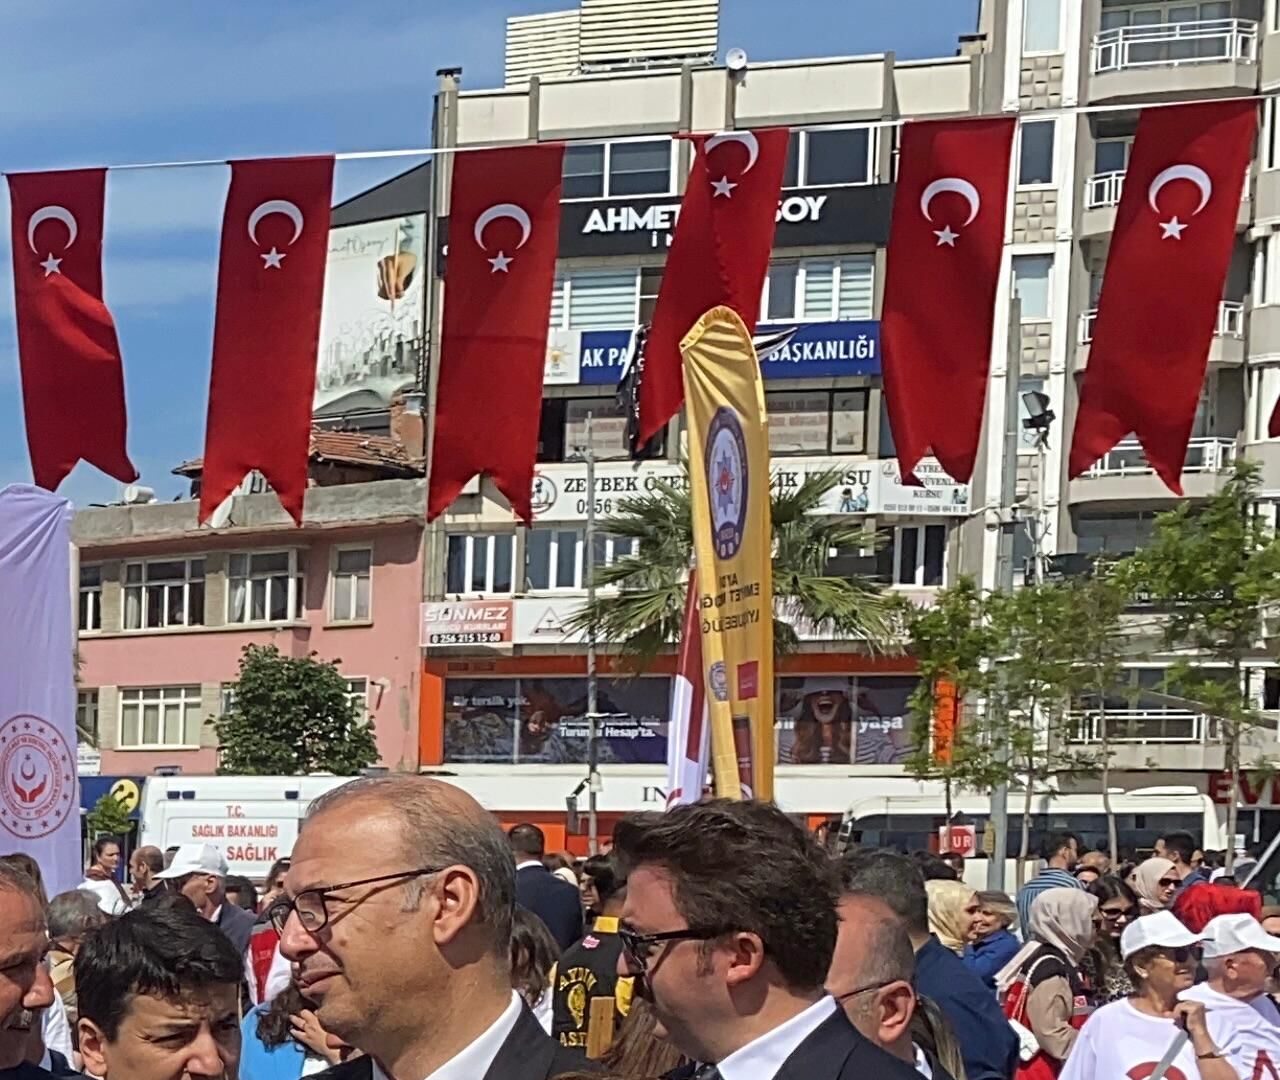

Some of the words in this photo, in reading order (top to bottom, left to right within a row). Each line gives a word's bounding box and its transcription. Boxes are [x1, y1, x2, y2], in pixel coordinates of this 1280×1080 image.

[582, 348, 604, 367] AK
[769, 335, 874, 364] BAŞKANLIĞI
[441, 634, 457, 643] 256
[858, 715, 904, 734] yaşa
[559, 727, 602, 738] Turunu
[226, 805, 246, 818] T.C.
[192, 823, 224, 838] SAĞLIK
[227, 823, 278, 838] BAKANLIĞI
[226, 843, 278, 861] SAĞLIK
